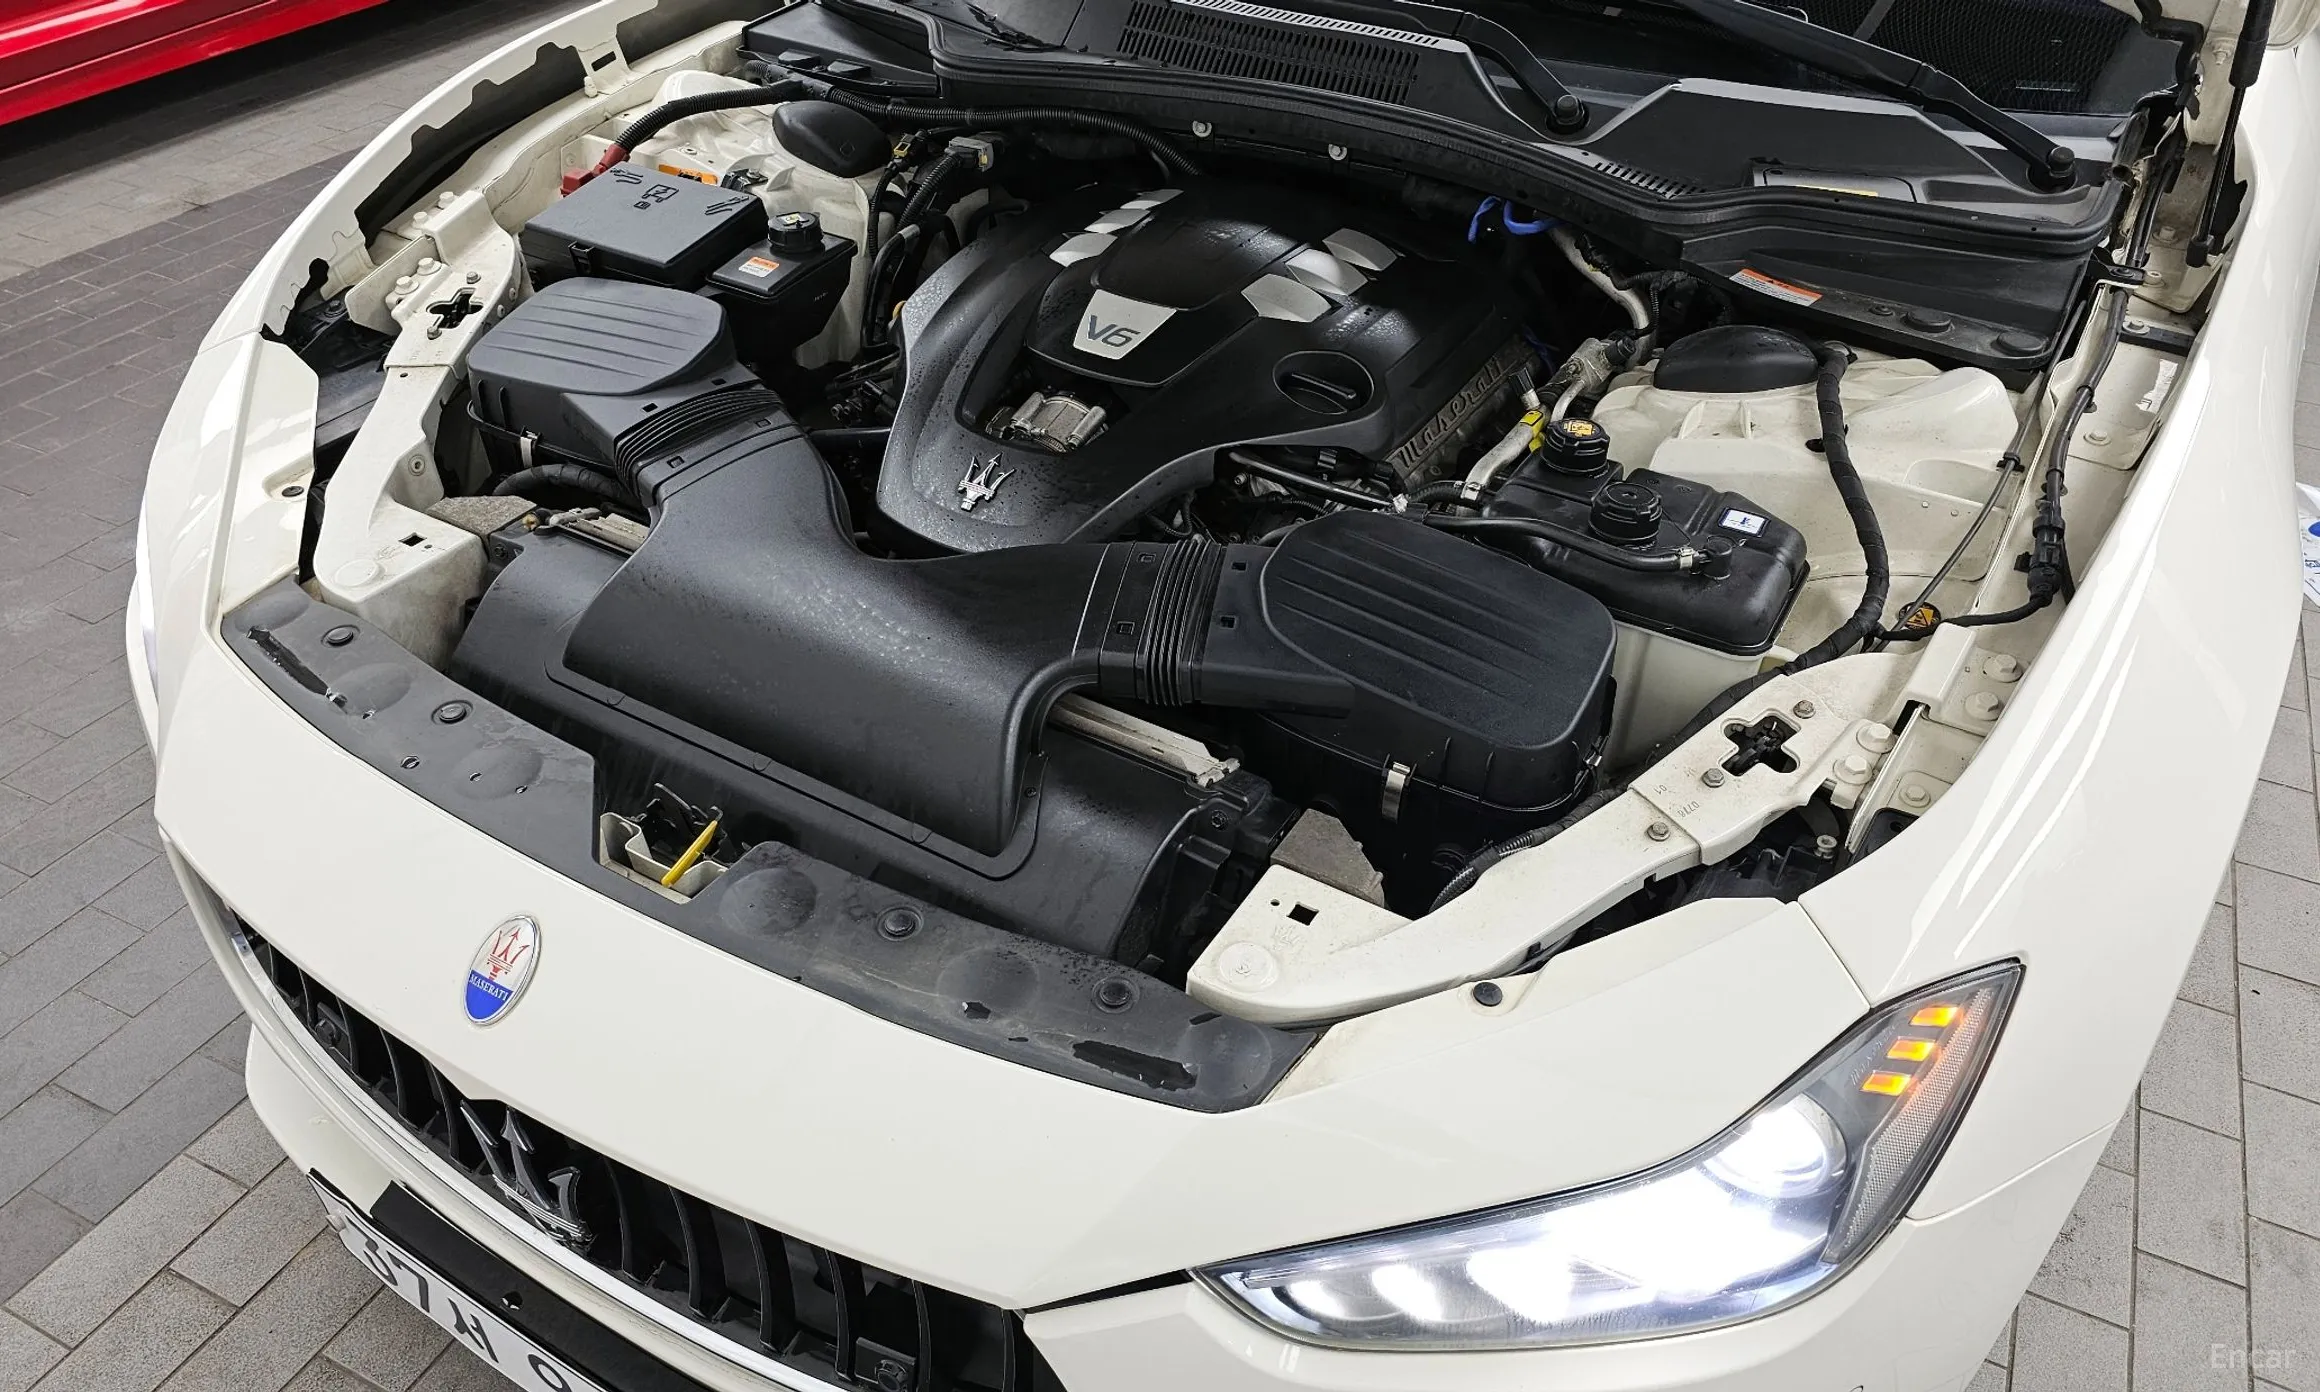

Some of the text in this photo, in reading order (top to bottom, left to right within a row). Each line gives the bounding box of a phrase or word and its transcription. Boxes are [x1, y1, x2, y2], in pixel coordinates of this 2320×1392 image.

[1087, 314, 1141, 347] V6
[1397, 355, 1504, 469] Maserati
[469, 974, 509, 1001] MASERATI
[345, 1213, 499, 1363] 37서
